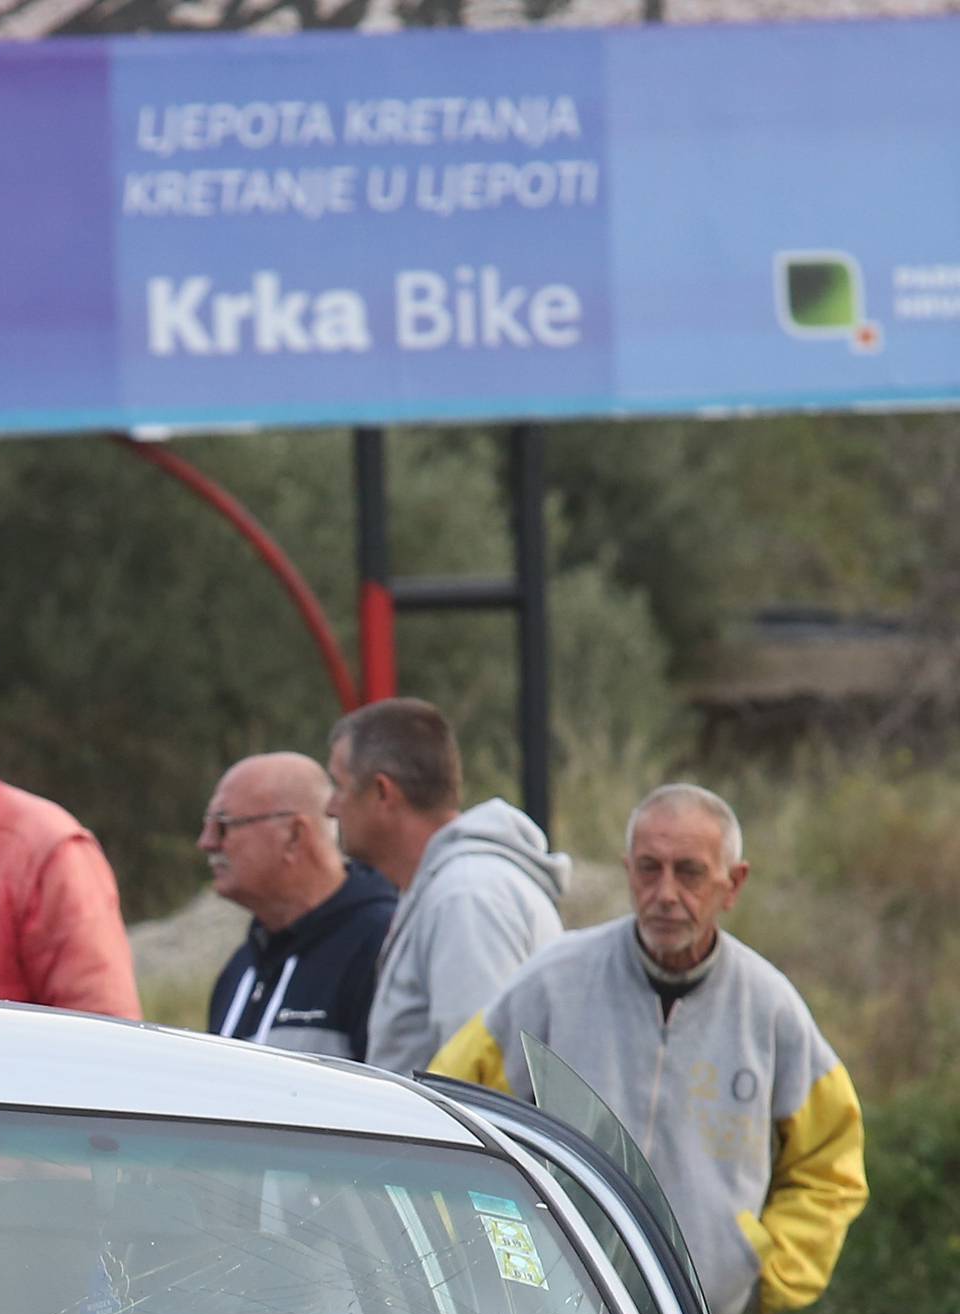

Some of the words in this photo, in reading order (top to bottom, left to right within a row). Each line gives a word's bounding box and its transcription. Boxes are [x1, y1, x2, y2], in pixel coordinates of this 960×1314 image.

[138, 102, 335, 155] LJEPOTA
[344, 97, 580, 148] KRETANJA
[123, 166, 358, 218] KRETANJE
[367, 166, 407, 212] U
[416, 161, 599, 216] LJEPOTI
[146, 269, 371, 355] Krka
[396, 265, 581, 350] Bike
